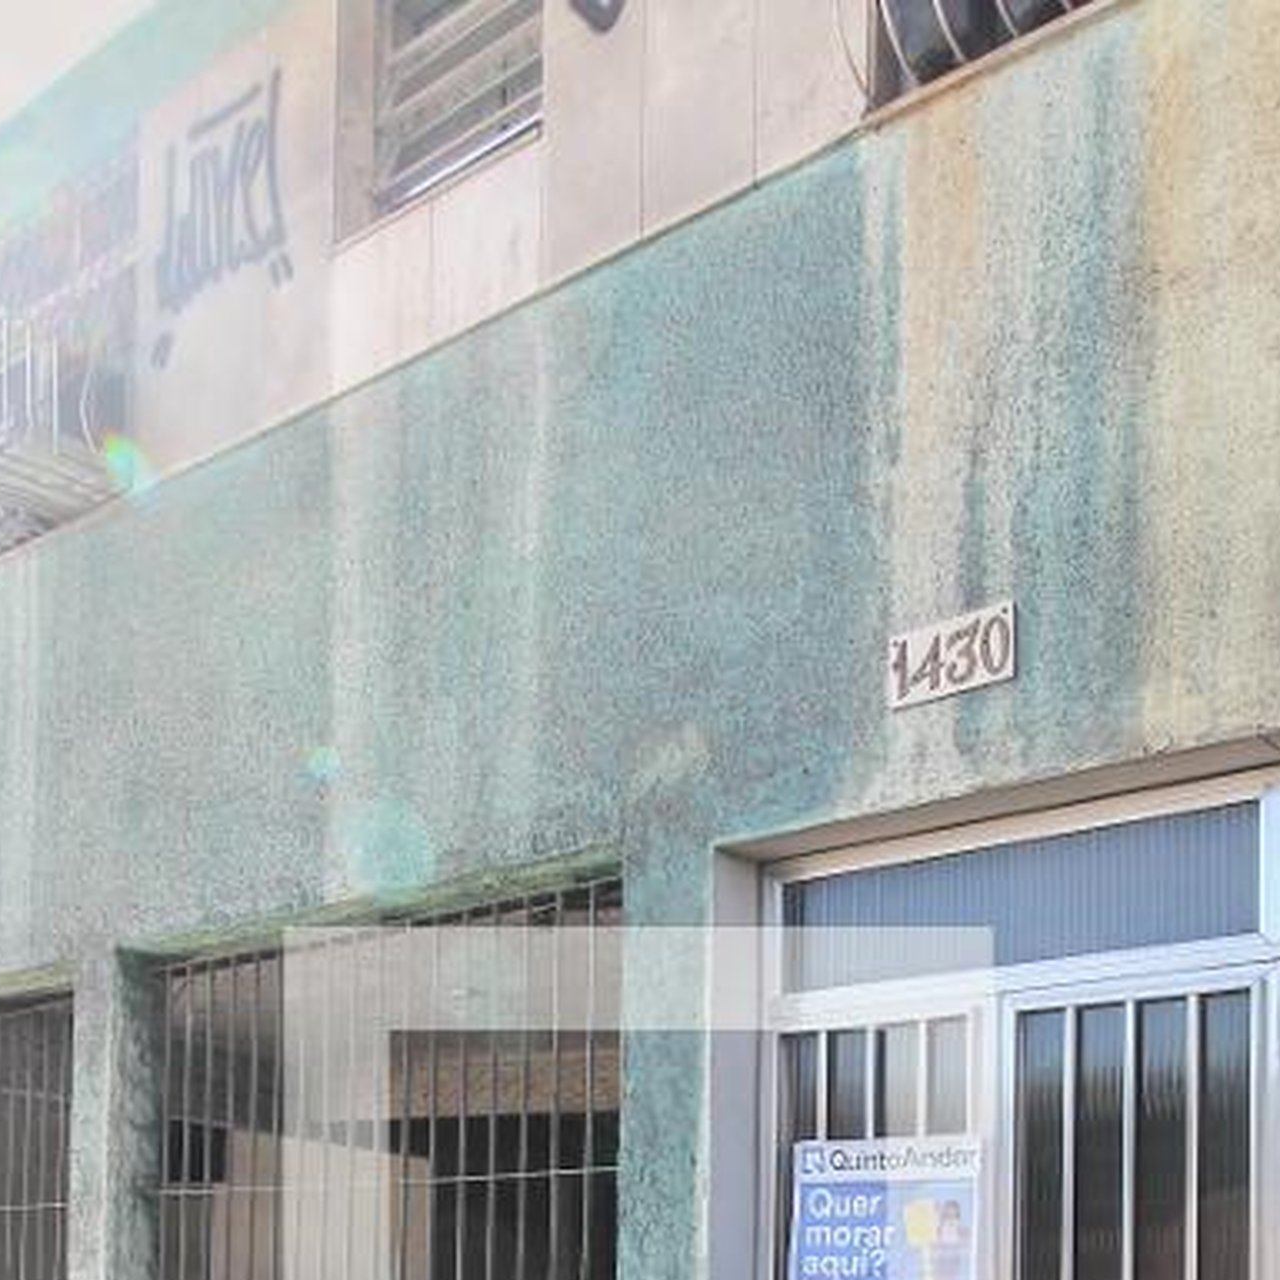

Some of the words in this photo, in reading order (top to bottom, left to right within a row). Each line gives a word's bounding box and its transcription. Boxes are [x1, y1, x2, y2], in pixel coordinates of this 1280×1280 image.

[892, 614, 1010, 700] 1430
[809, 1187, 881, 1220] Quer
[805, 1225, 895, 1249] morar
